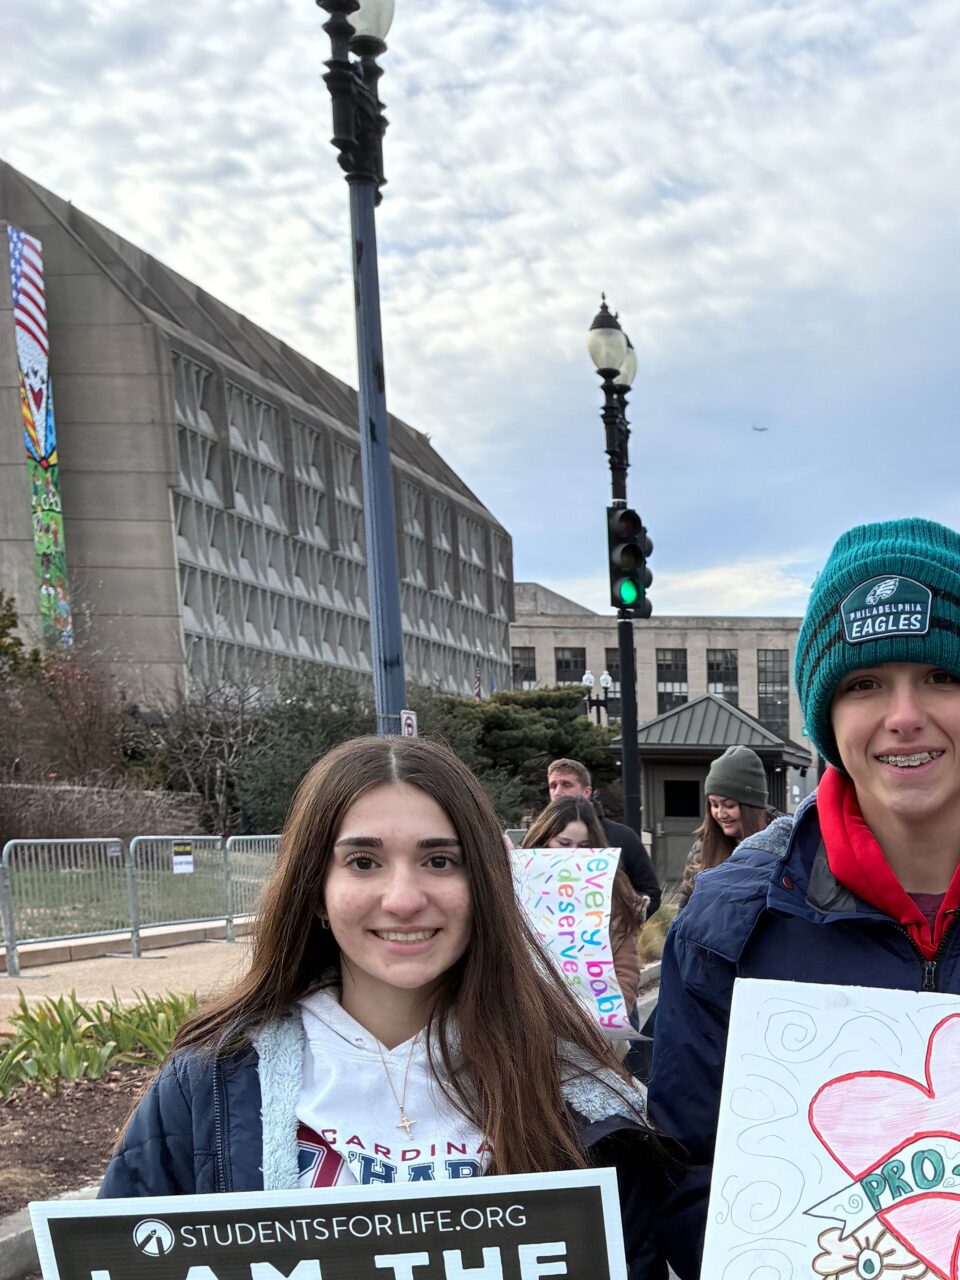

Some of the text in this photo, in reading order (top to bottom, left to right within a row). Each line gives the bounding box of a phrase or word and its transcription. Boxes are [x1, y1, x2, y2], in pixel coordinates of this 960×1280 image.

[850, 603, 921, 620] PHILADELPHIA
[852, 614, 921, 637] EAGLES
[581, 858, 625, 1029] every baby
[180, 1205, 527, 1249] STUDENTSFORLIFE.ORG
